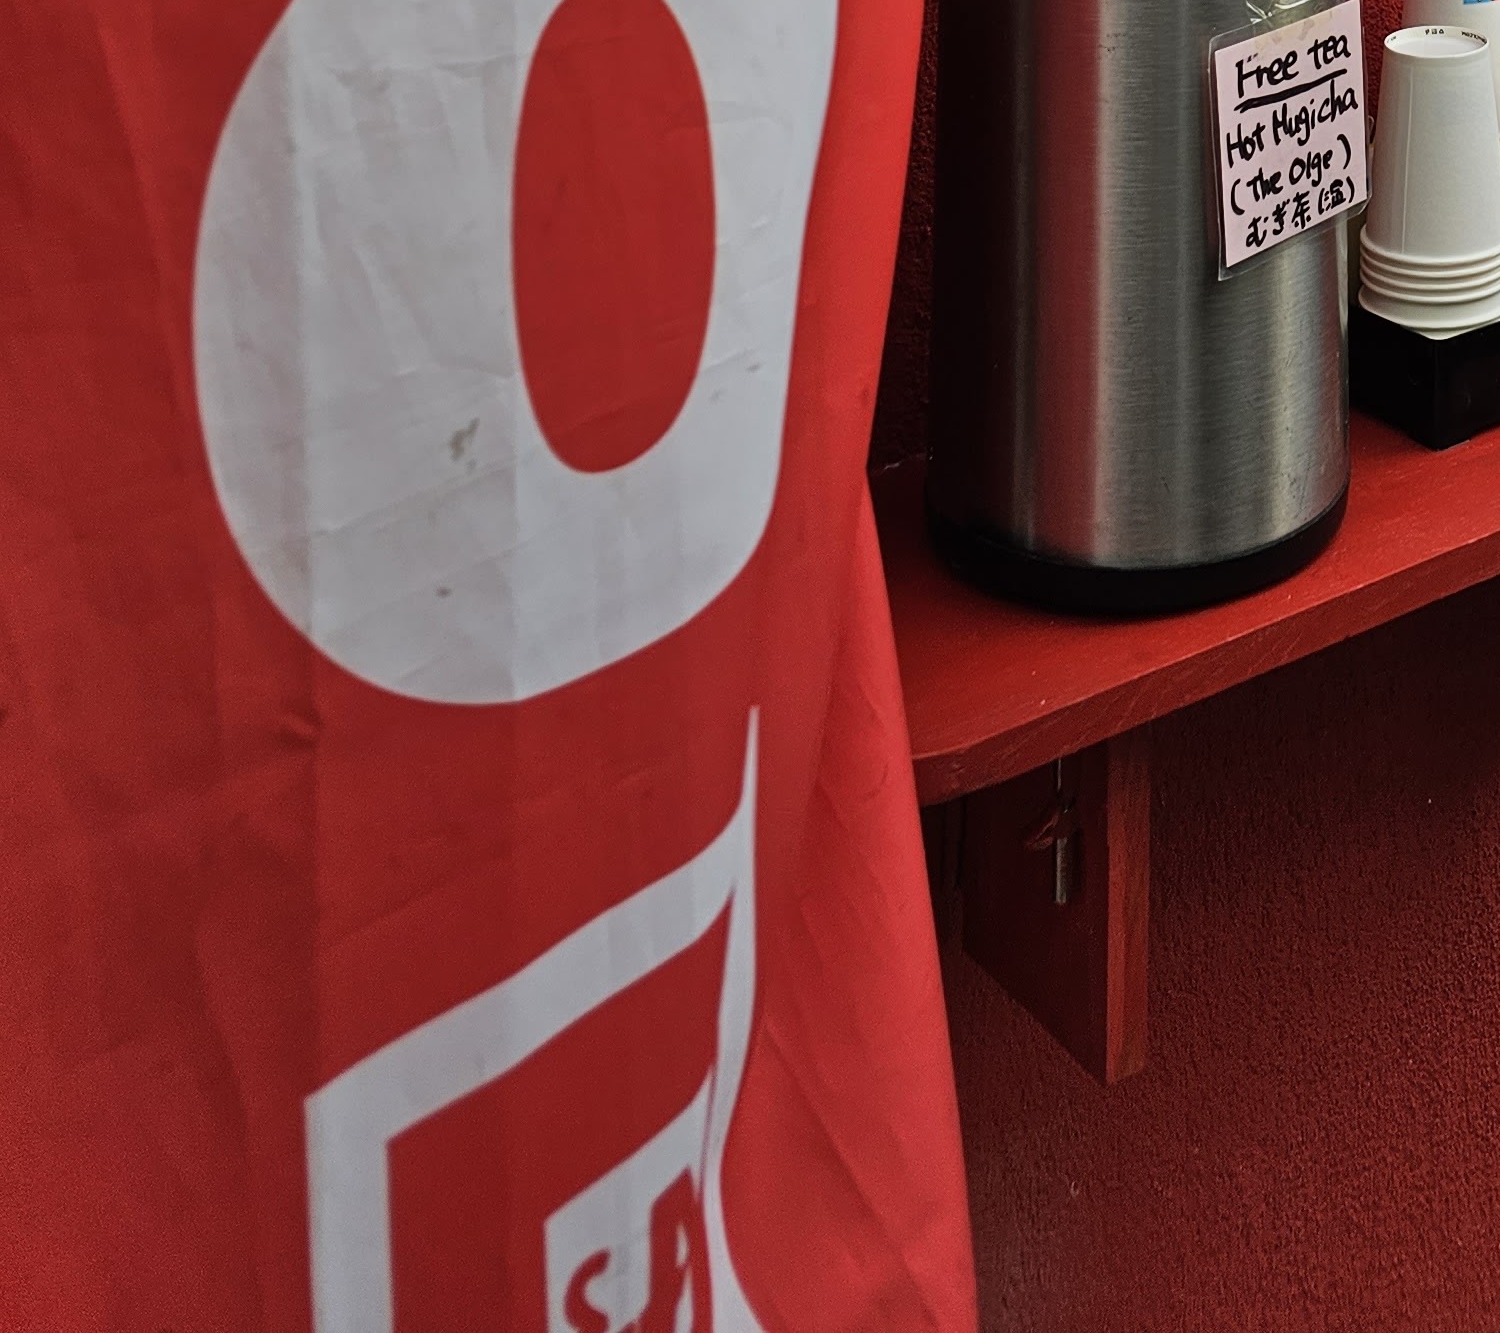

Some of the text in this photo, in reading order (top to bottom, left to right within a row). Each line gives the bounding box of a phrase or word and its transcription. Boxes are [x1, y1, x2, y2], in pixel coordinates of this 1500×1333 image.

[1235, 34, 1352, 99] Free tea
[1226, 79, 1359, 169] Hot Mugicha
